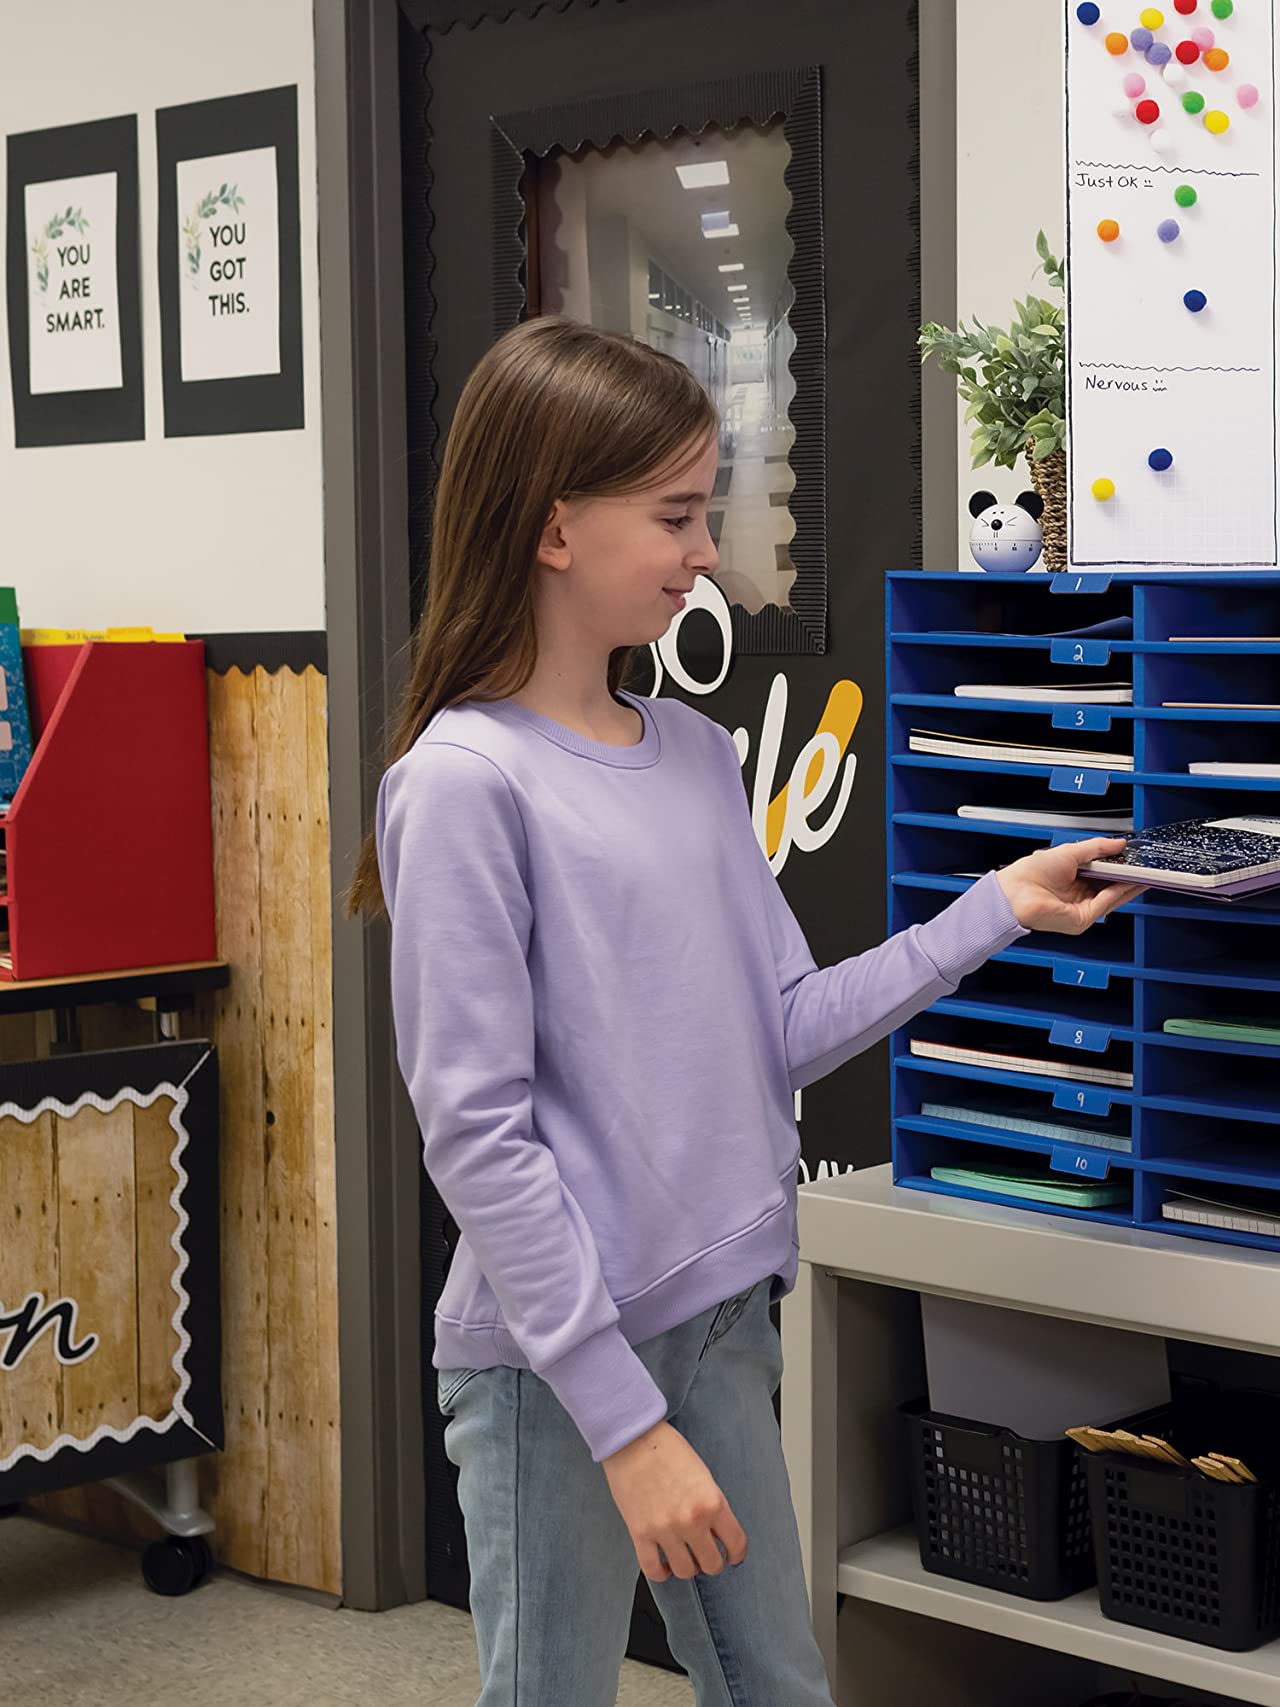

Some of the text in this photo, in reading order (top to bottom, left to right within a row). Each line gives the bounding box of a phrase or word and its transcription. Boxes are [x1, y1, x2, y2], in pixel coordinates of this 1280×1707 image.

[1075, 173, 1138, 189] Just OK
[209, 223, 246, 248] YOU
[57, 244, 90, 267] YOU
[209, 257, 247, 282] GOT
[59, 276, 91, 300] ARE
[208, 292, 250, 316] THIS.
[46, 308, 105, 333] SMART.
[1085, 374, 1148, 392] Nervous
[1074, 576, 1082, 591] 1
[1073, 644, 1084, 662] 2
[1075, 710, 1085, 726] 3
[1074, 773, 1084, 790] 4
[1077, 969, 1085, 984] 7
[1074, 1030, 1083, 1044] 8
[1077, 1092, 1085, 1108] 9
[1075, 1156, 1088, 1170] 10
